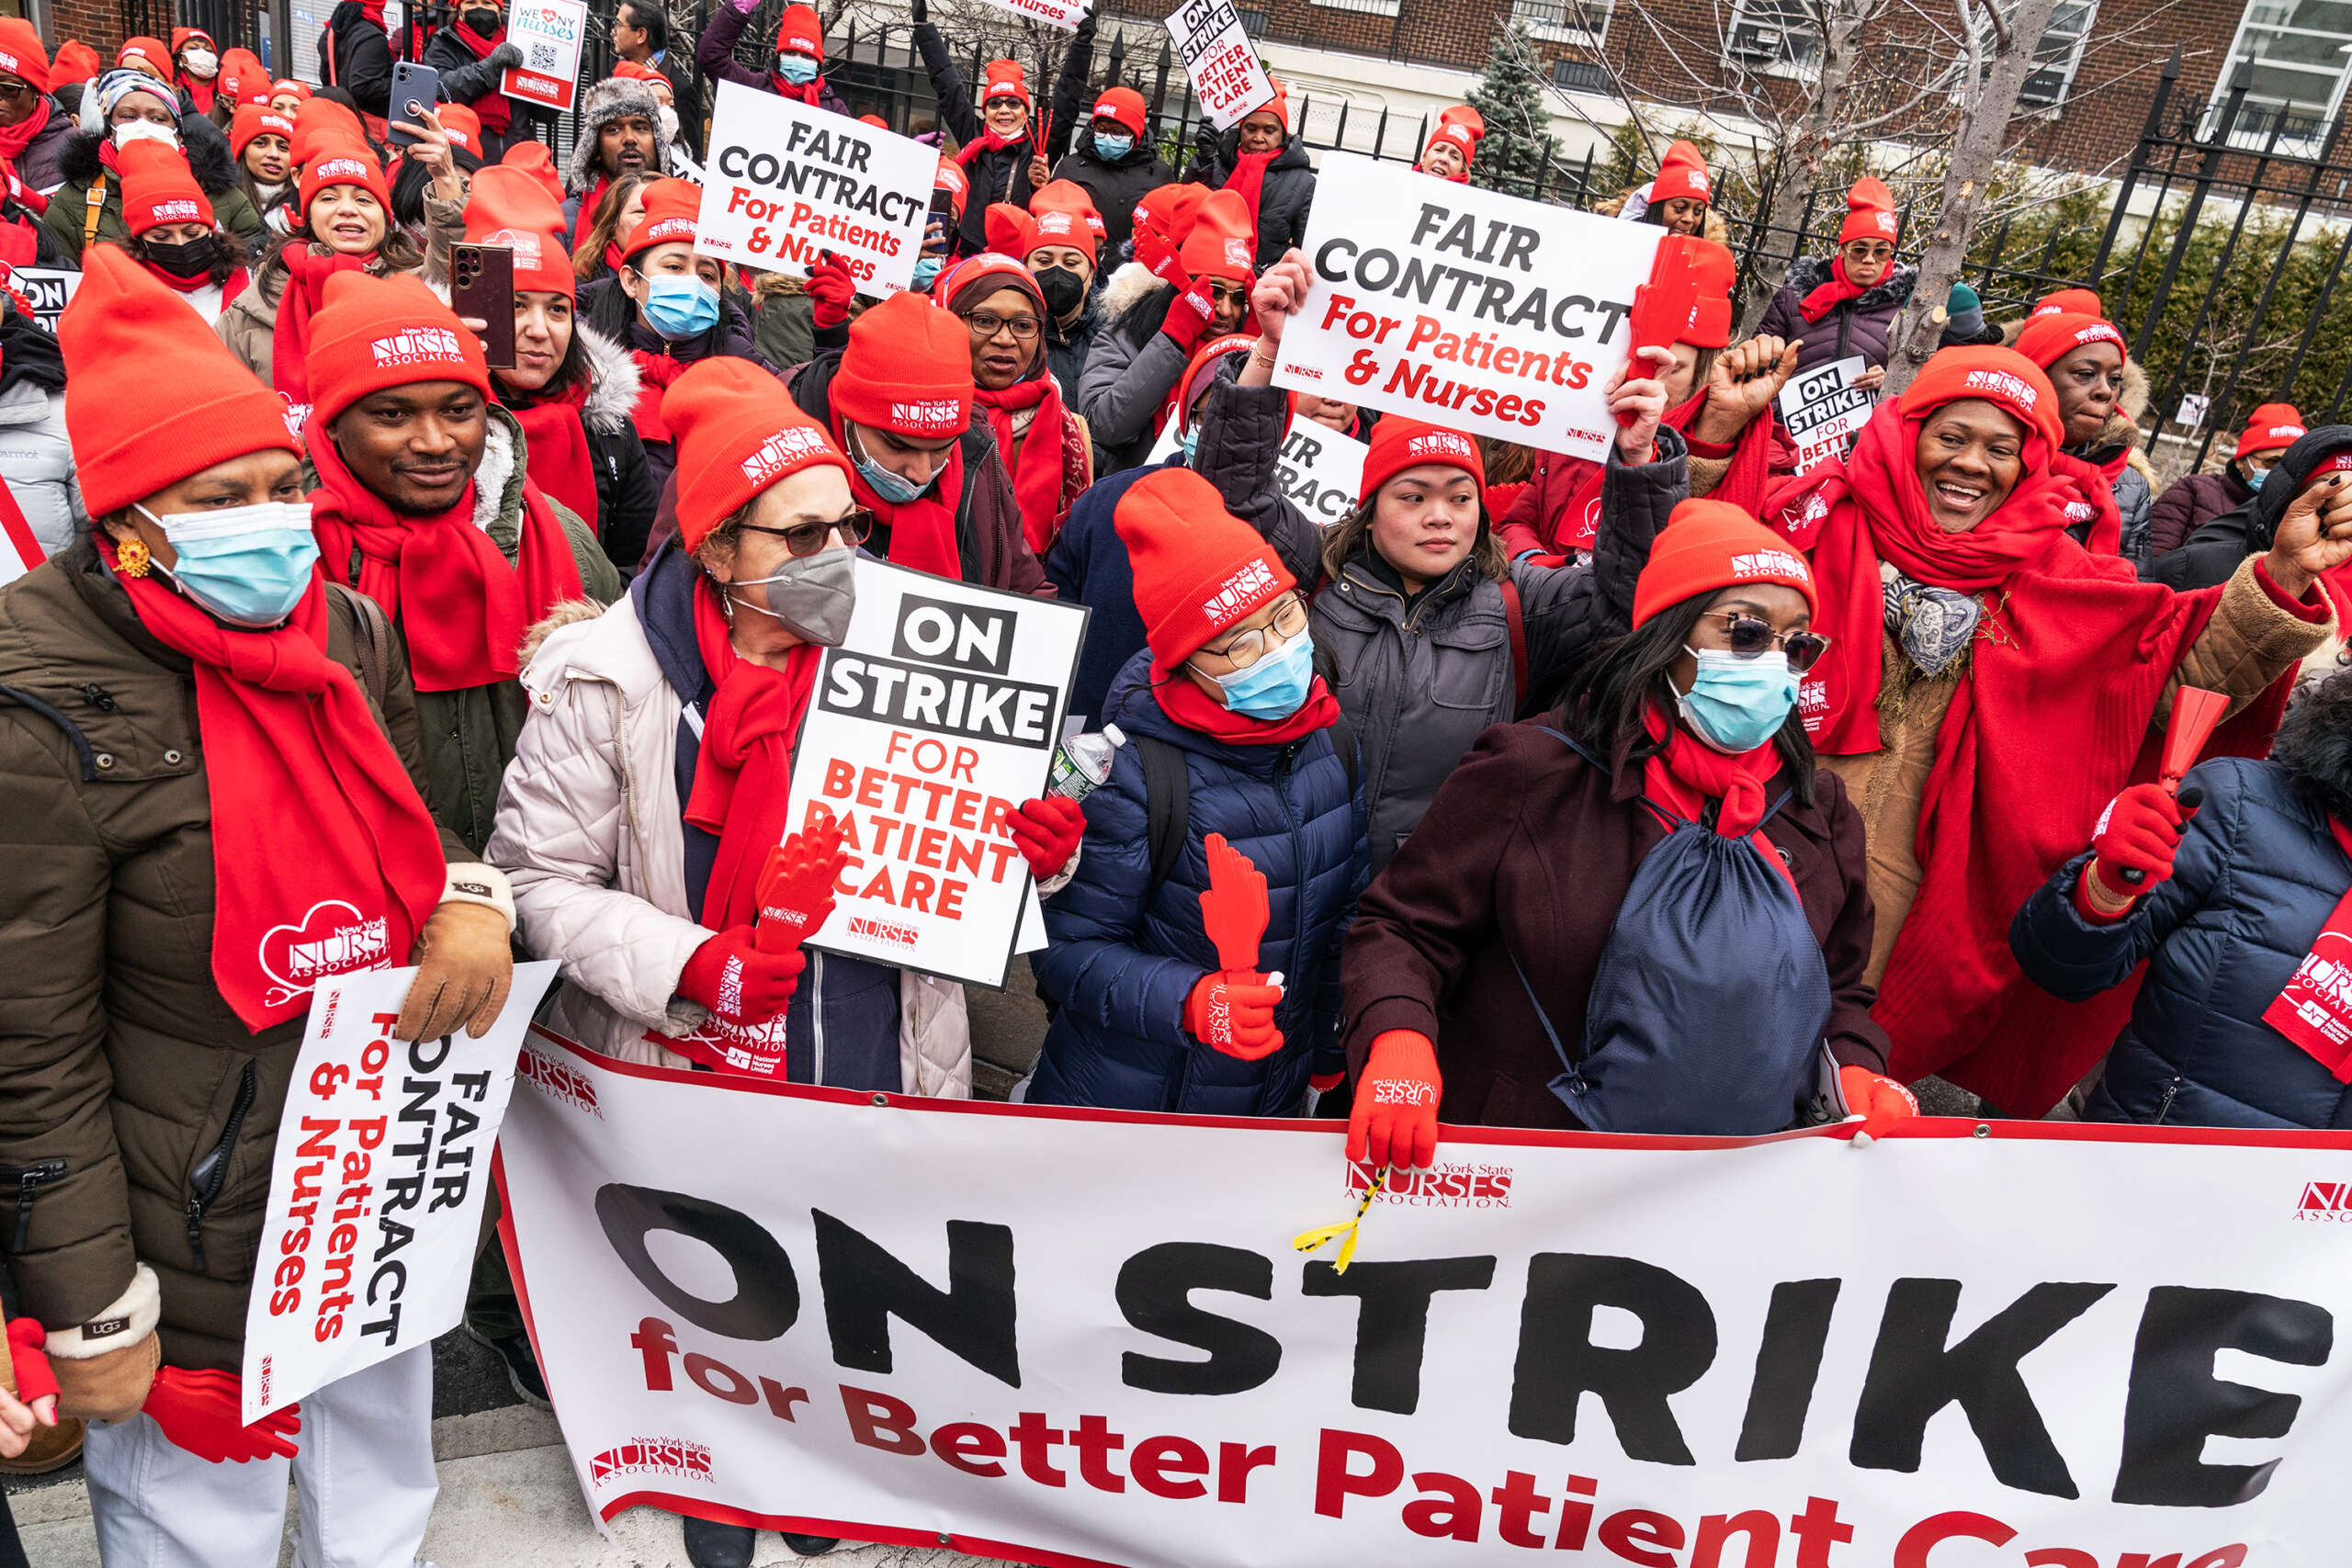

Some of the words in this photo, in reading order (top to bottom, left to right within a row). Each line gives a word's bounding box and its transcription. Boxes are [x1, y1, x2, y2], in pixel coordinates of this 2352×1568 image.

[516, 16, 574, 39] nurses
[520, 7, 539, 18] WE
[557, 16, 575, 28] NY
[1186, 0, 1210, 28] ON
[1182, 5, 1234, 64] STRIKE
[1203, 39, 1227, 64] FOR
[1198, 44, 1245, 87] BETTER
[1199, 55, 1253, 103] PATIENT
[516, 75, 559, 96] NURSES
[1214, 77, 1252, 109] CARE
[786, 120, 871, 174] FAIR
[718, 145, 924, 228] CONTRACT
[727, 186, 784, 223] For
[789, 201, 901, 257] Patients
[747, 226, 772, 254] &
[1410, 203, 1541, 272] FAIR
[1315, 237, 1632, 345] CONTRACT
[371, 333, 461, 360] NURSES
[377, 351, 466, 368] ASSOCIATION
[1320, 294, 1402, 344] For
[1406, 314, 1594, 390] Patients
[1285, 363, 1324, 379] NURSES
[1344, 348, 1380, 386] &
[1383, 358, 1546, 427] Nurses
[1803, 371, 1838, 400] ON
[892, 402, 959, 423] NURSES
[1788, 389, 1866, 435] STRIKE
[1965, 382, 2033, 412] ASSOCIATION
[892, 418, 958, 430] ASSOCIATION
[1566, 427, 1606, 443] NURSES
[1815, 417, 1849, 440] FOR
[741, 429, 826, 480] NURSES
[1279, 431, 1323, 468] IR
[1802, 427, 1858, 461] BETT
[752, 446, 833, 488] ASSOCIATION
[1203, 562, 1274, 621] NURSES
[1213, 580, 1279, 627] ASSOCIATION
[902, 606, 1002, 667] ON
[826, 658, 1049, 742] STRIKE
[885, 729, 978, 784] FOR
[821, 758, 1015, 840] BETTER
[805, 799, 1019, 883] PATIENT
[832, 856, 967, 920] CARE
[334, 925, 362, 938] New
[363, 916, 387, 933] York
[762, 905, 808, 926] NURSES
[847, 916, 919, 945] NURSES
[289, 924, 386, 970] NURS
[289, 947, 387, 978] ASSOCIATI
[321, 991, 340, 1039] NURSES
[2324, 1022, 2349, 1042] Nurses
[2330, 1017, 2352, 1038] Nation
[524, 1043, 546, 1061] New
[2320, 1026, 2345, 1045] United
[356, 1012, 398, 1101] For
[751, 1066, 774, 1075] United
[752, 1060, 776, 1070] Nurses
[753, 1054, 781, 1065] National
[310, 1062, 350, 1100] &
[515, 1049, 597, 1107] URSES
[1375, 1084, 1434, 1103] URSES
[427, 1070, 491, 1213] FAIR
[1344, 1160, 1512, 1198] NURSES
[1443, 1162, 1474, 1175] York
[1478, 1164, 1513, 1176] State
[360, 1035, 450, 1347] ONTRACT
[269, 1114, 341, 1317] Nurses
[315, 1114, 388, 1343] Patients
[93, 1321, 120, 1334] UGG
[594, 1182, 1021, 1389] ON
[1115, 1242, 2334, 1507] STRIKE
[261, 1357, 273, 1406] NURSES
[630, 1316, 809, 1423] for
[838, 1383, 1276, 1504] Better
[1315, 1427, 1854, 1568] Patient
[632, 1435, 659, 1446] New
[660, 1436, 684, 1449] York
[684, 1438, 710, 1453] State
[590, 1445, 712, 1480] NURSES
[594, 1464, 717, 1491] ASSOCIATION
